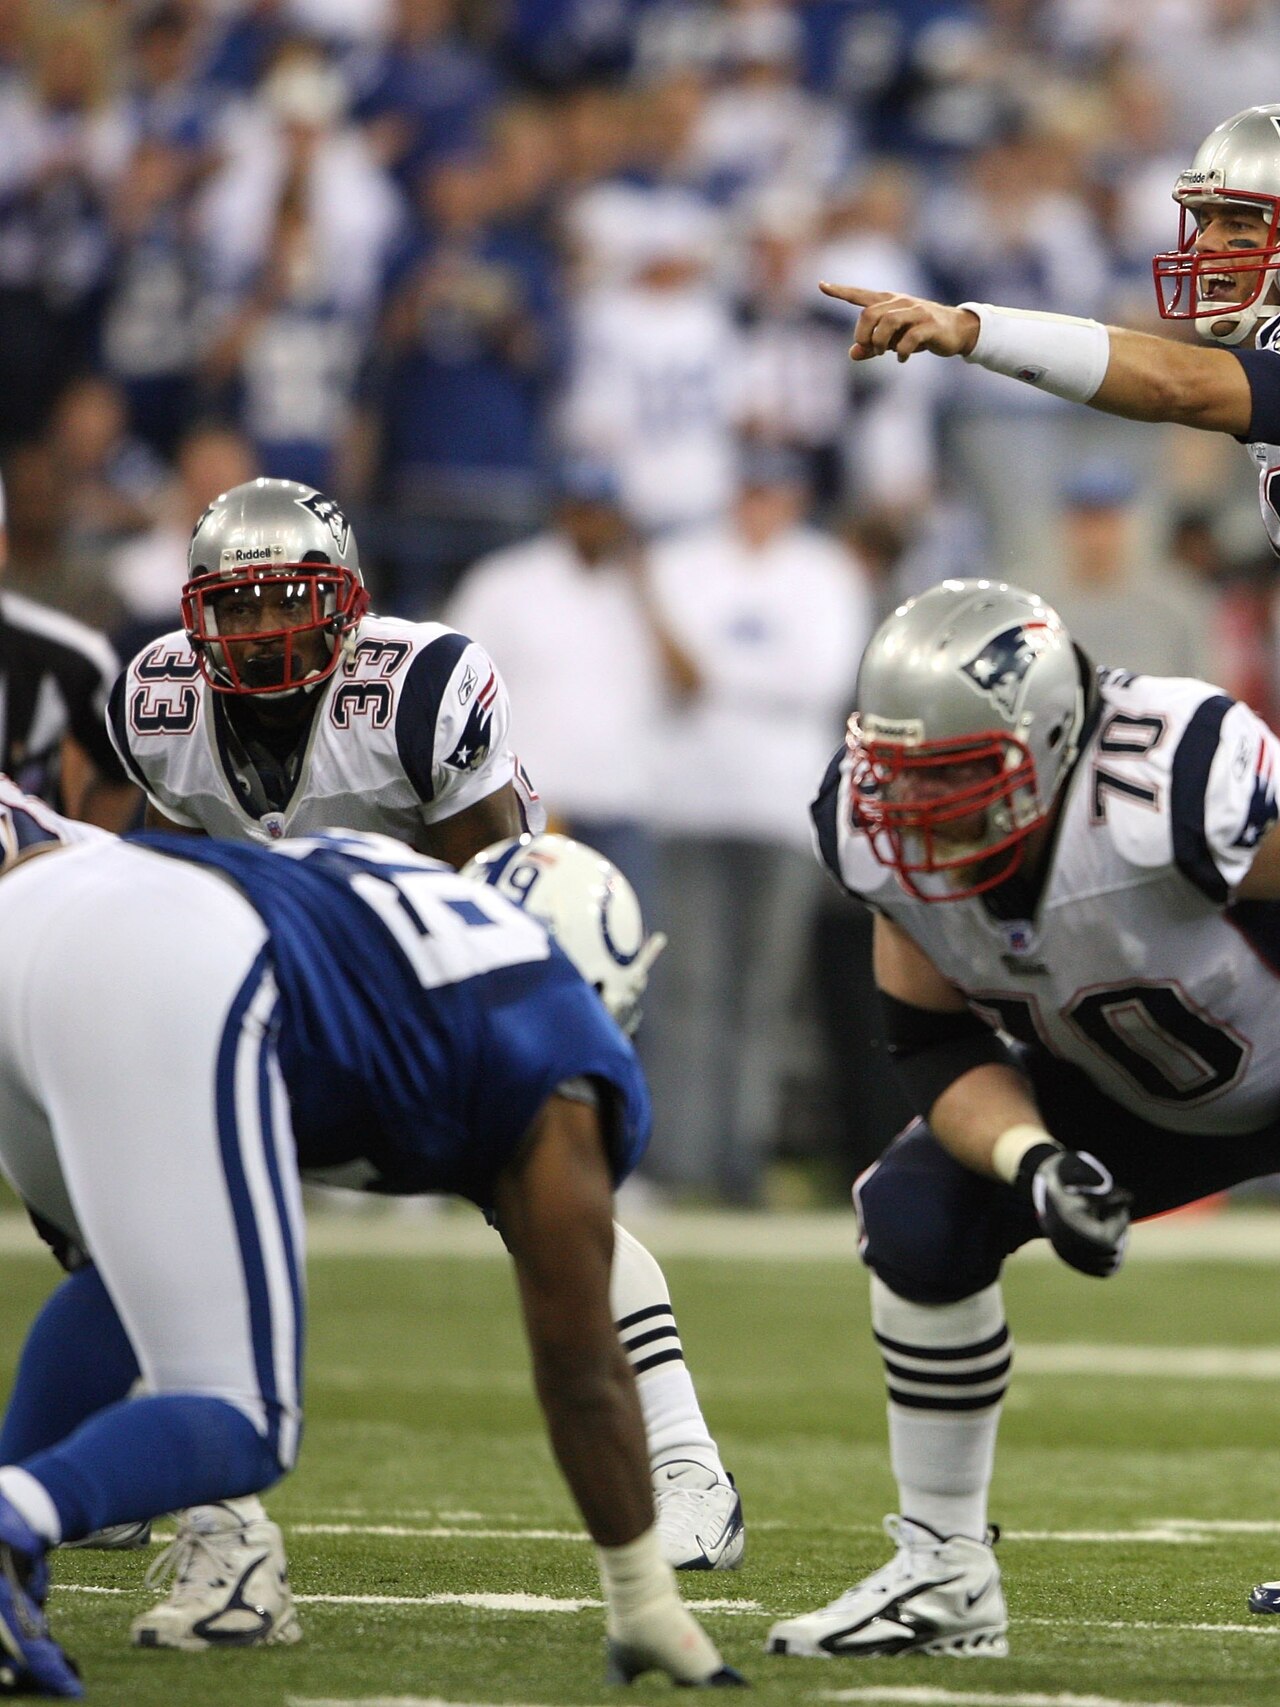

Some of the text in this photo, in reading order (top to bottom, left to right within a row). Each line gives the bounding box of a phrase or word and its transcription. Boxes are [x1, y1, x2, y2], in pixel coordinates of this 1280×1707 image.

[235, 547, 272, 561] Riddell
[129, 643, 204, 736] 33
[330, 636, 413, 730] 33
[1089, 709, 1169, 827] 70
